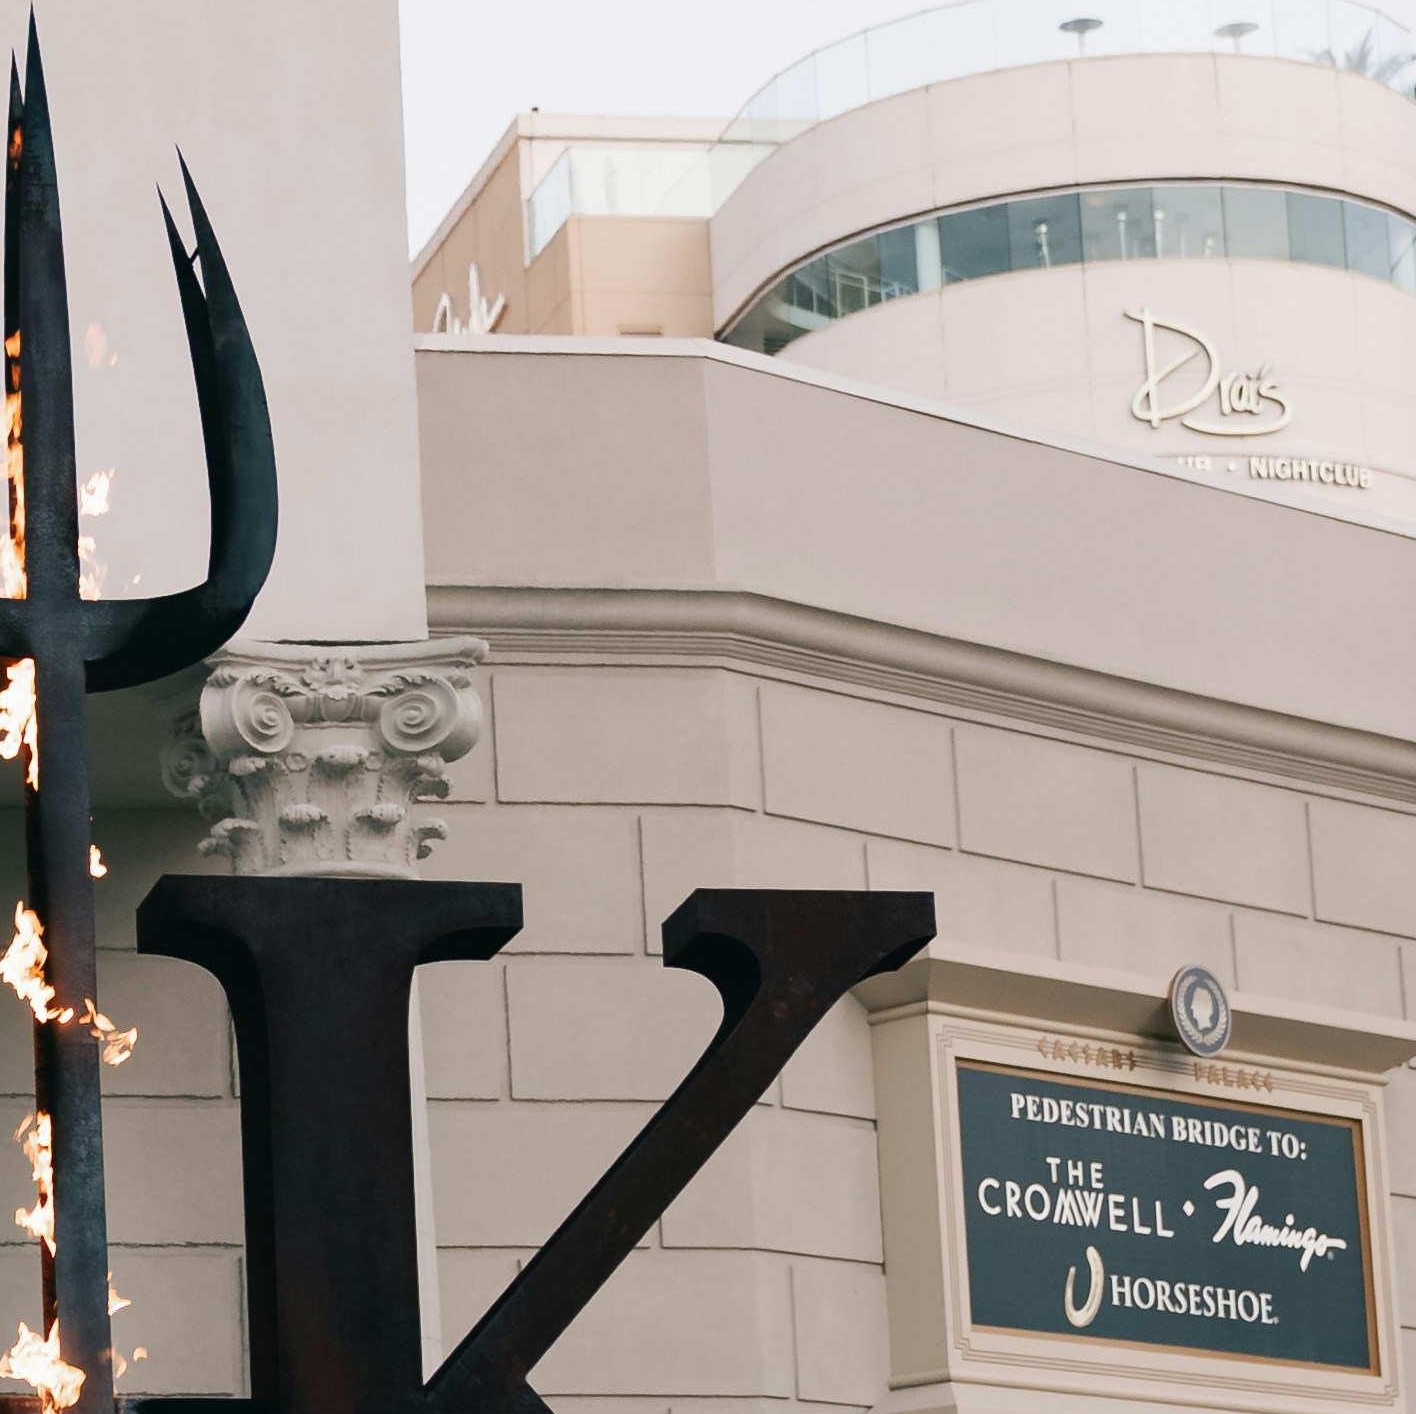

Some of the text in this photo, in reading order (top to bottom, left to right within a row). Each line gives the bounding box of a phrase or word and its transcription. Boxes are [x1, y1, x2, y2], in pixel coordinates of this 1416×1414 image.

[1123, 307, 1293, 437] Drai's
[1248, 455, 1373, 489] NIGHTCLUB
[1037, 1036, 1273, 1093] CAESARS PALACE
[1010, 1092, 1308, 1161] PEDESTRIAN BRIDGE TO:
[1045, 1156, 1104, 1189] THE
[978, 1177, 1175, 1238] CROMWELL
[1203, 1169, 1347, 1272] Flamingo
[1109, 1274, 1274, 1325] HORSESHOE
